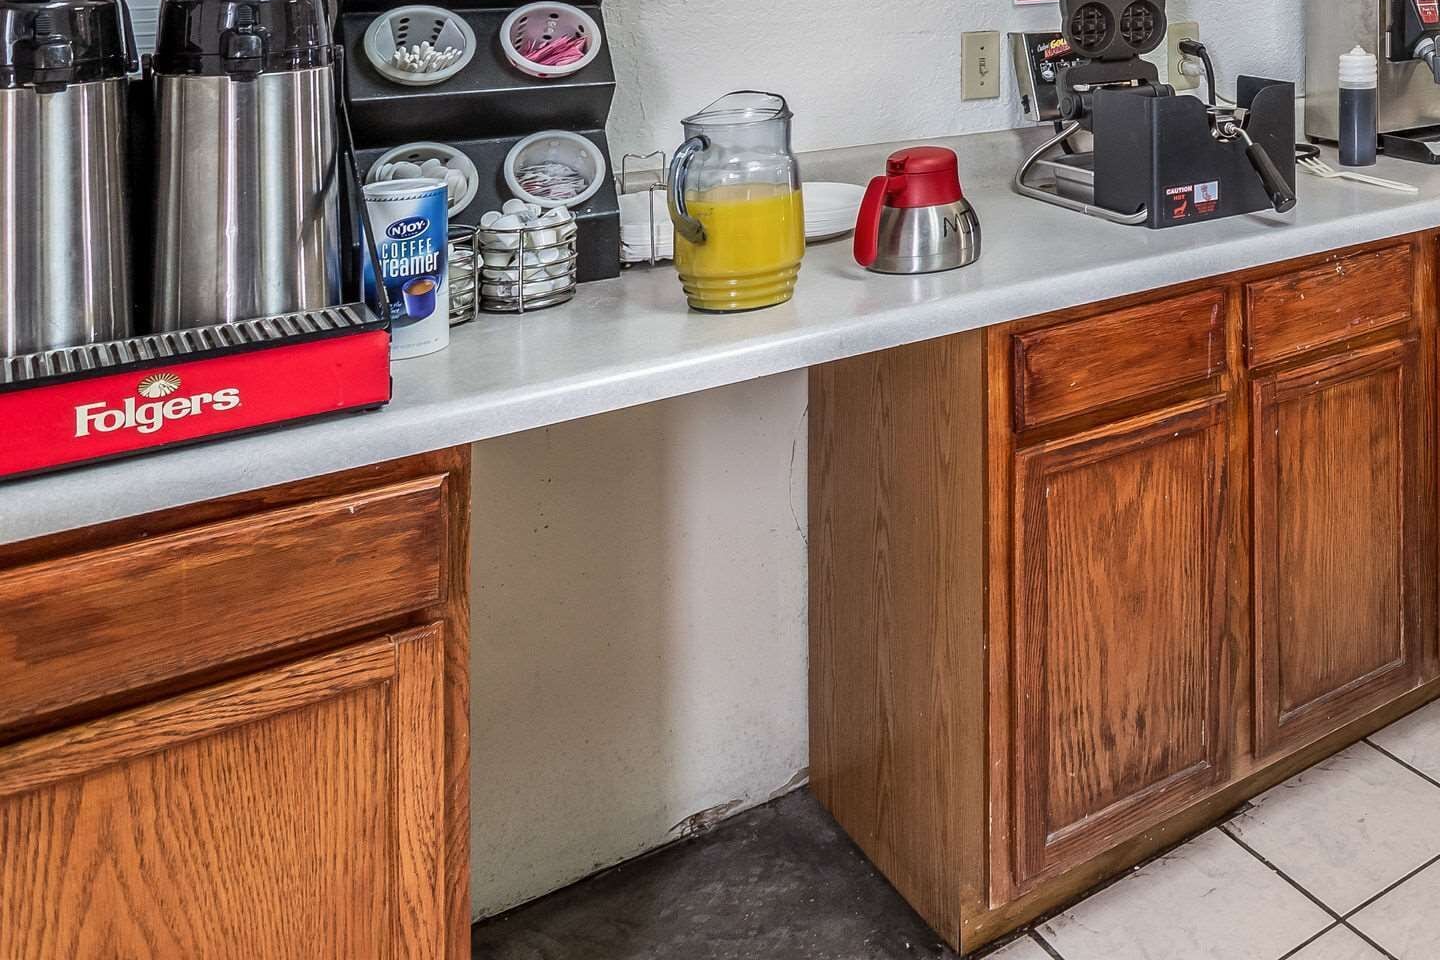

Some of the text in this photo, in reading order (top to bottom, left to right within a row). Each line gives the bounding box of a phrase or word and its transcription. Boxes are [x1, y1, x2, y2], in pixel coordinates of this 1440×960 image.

[1166, 185, 1193, 195] CAUTION
[382, 238, 432, 259] COFFEE
[380, 251, 439, 278] reamer
[74, 388, 240, 438] Folgers
